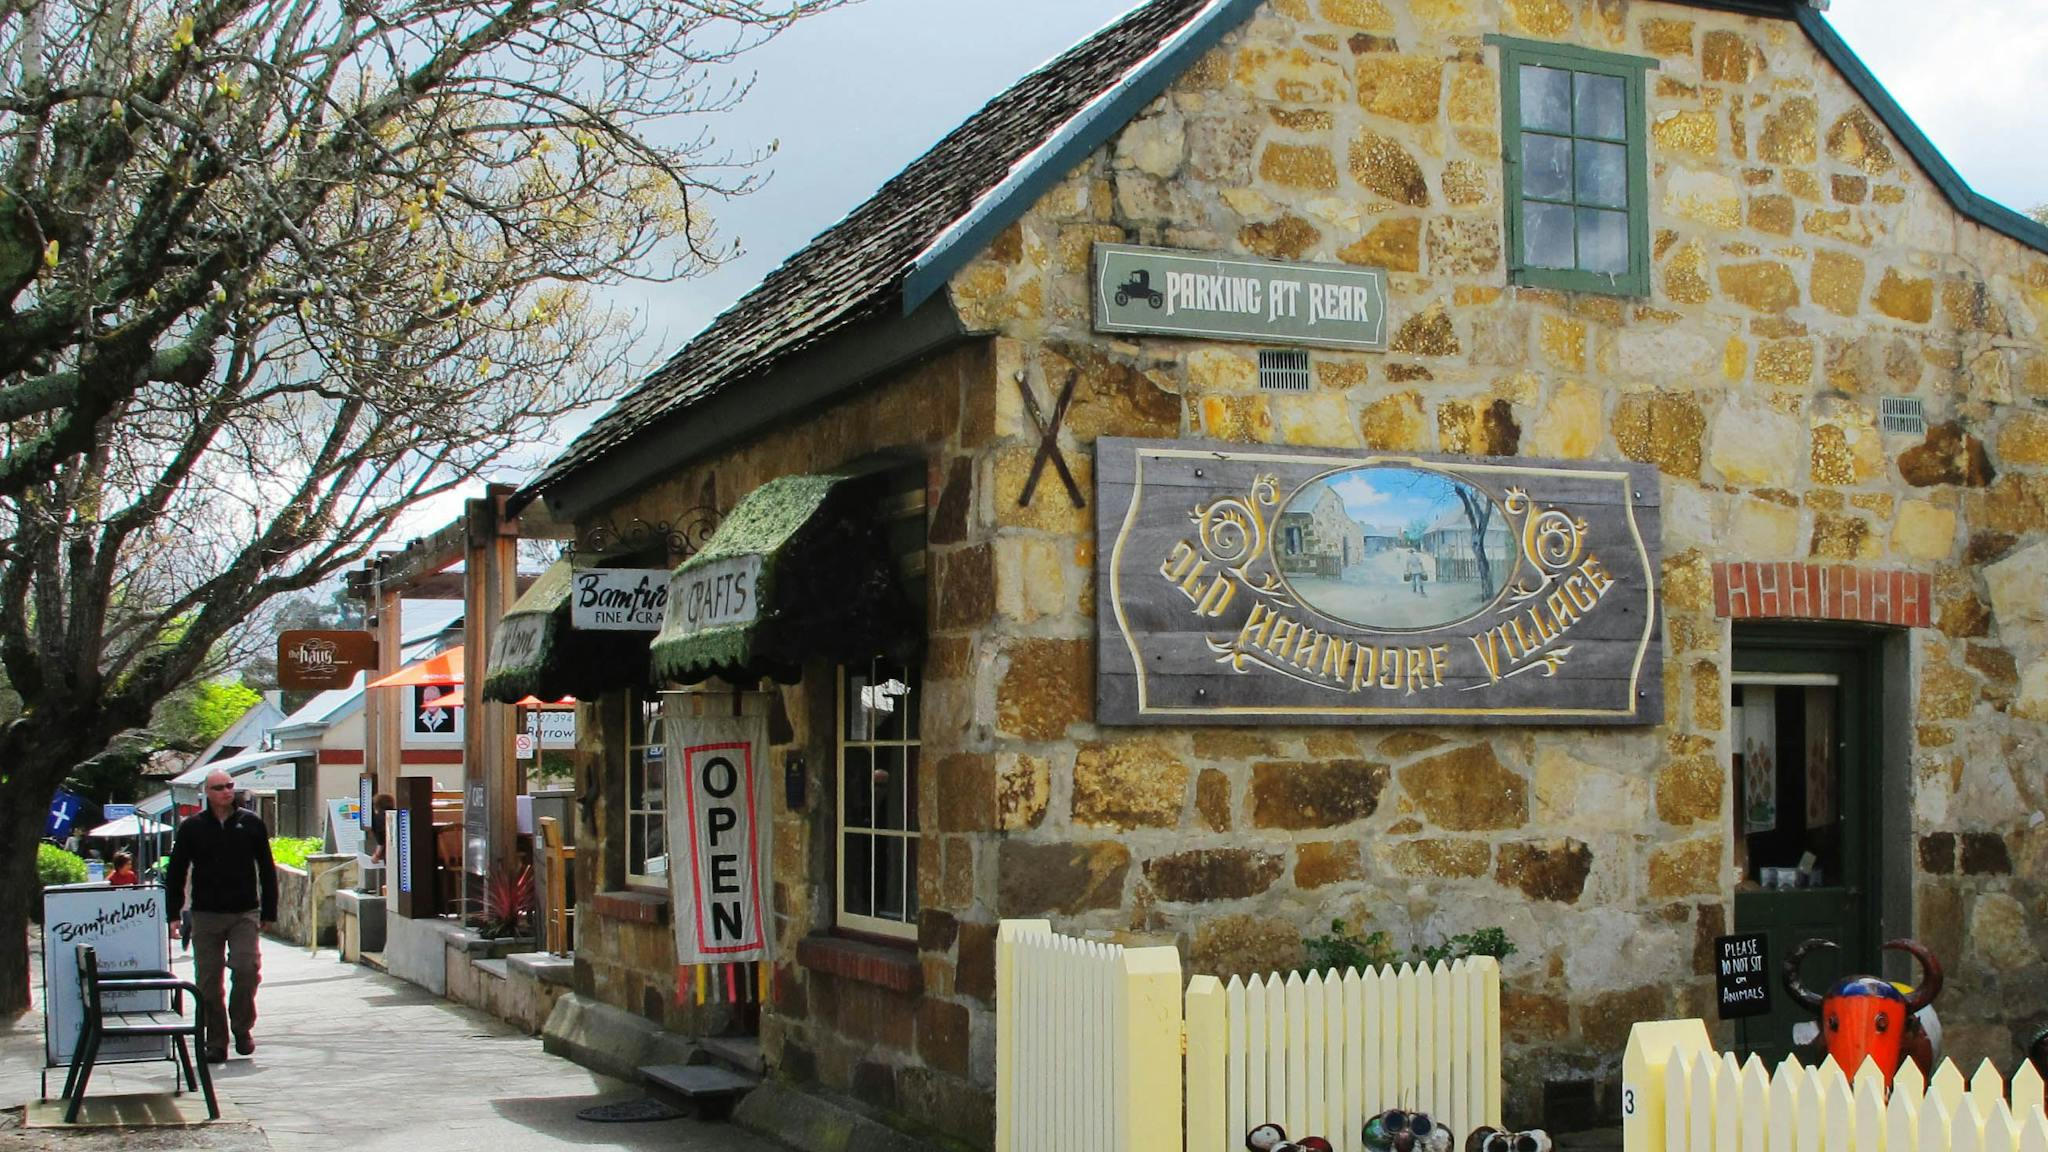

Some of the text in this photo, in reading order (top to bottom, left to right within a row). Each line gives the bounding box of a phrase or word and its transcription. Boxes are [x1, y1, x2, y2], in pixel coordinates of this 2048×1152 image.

[1166, 271, 1369, 325] PARKING AT REAR
[595, 611, 623, 624] FINE
[1159, 538, 1616, 697] OLD HAHNDORF VILLAGE
[702, 757, 743, 941] OPEN
[52, 898, 157, 942] Bamfurlong
[1724, 939, 1758, 957] PLEASE
[1732, 957, 1748, 974] NOT
[1750, 955, 1762, 972] SIT
[1625, 1089, 1635, 1115] 3
